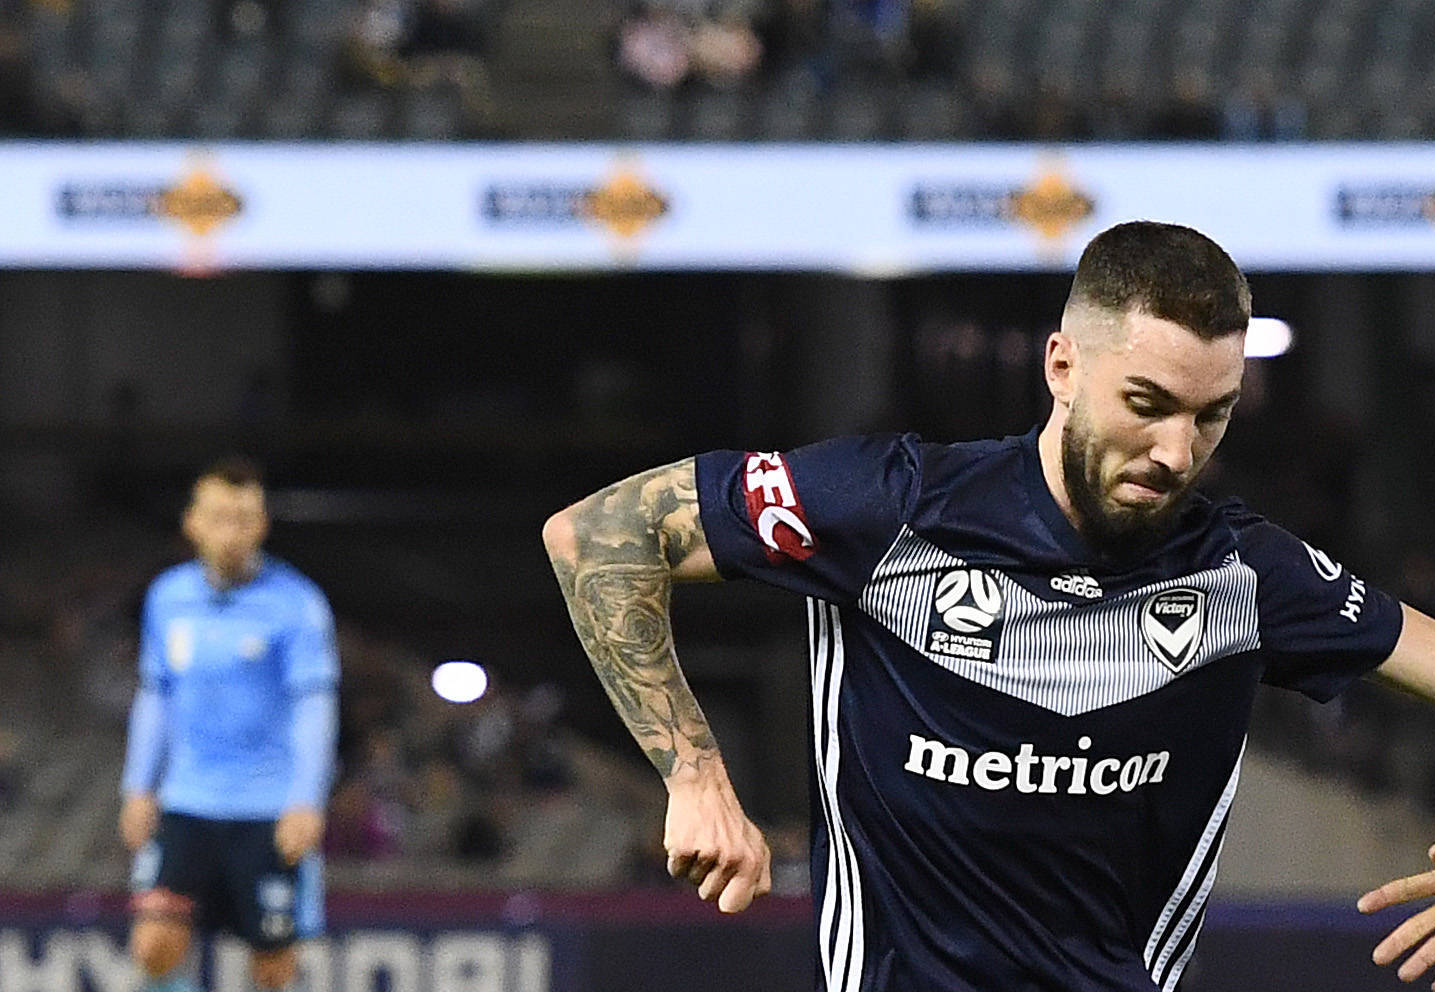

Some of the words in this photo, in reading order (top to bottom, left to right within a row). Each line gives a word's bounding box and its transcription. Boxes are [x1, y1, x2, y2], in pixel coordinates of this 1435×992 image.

[1051, 575, 1102, 598] adidas
[1155, 602, 1195, 616] Victory
[904, 734, 1170, 795] metricon
